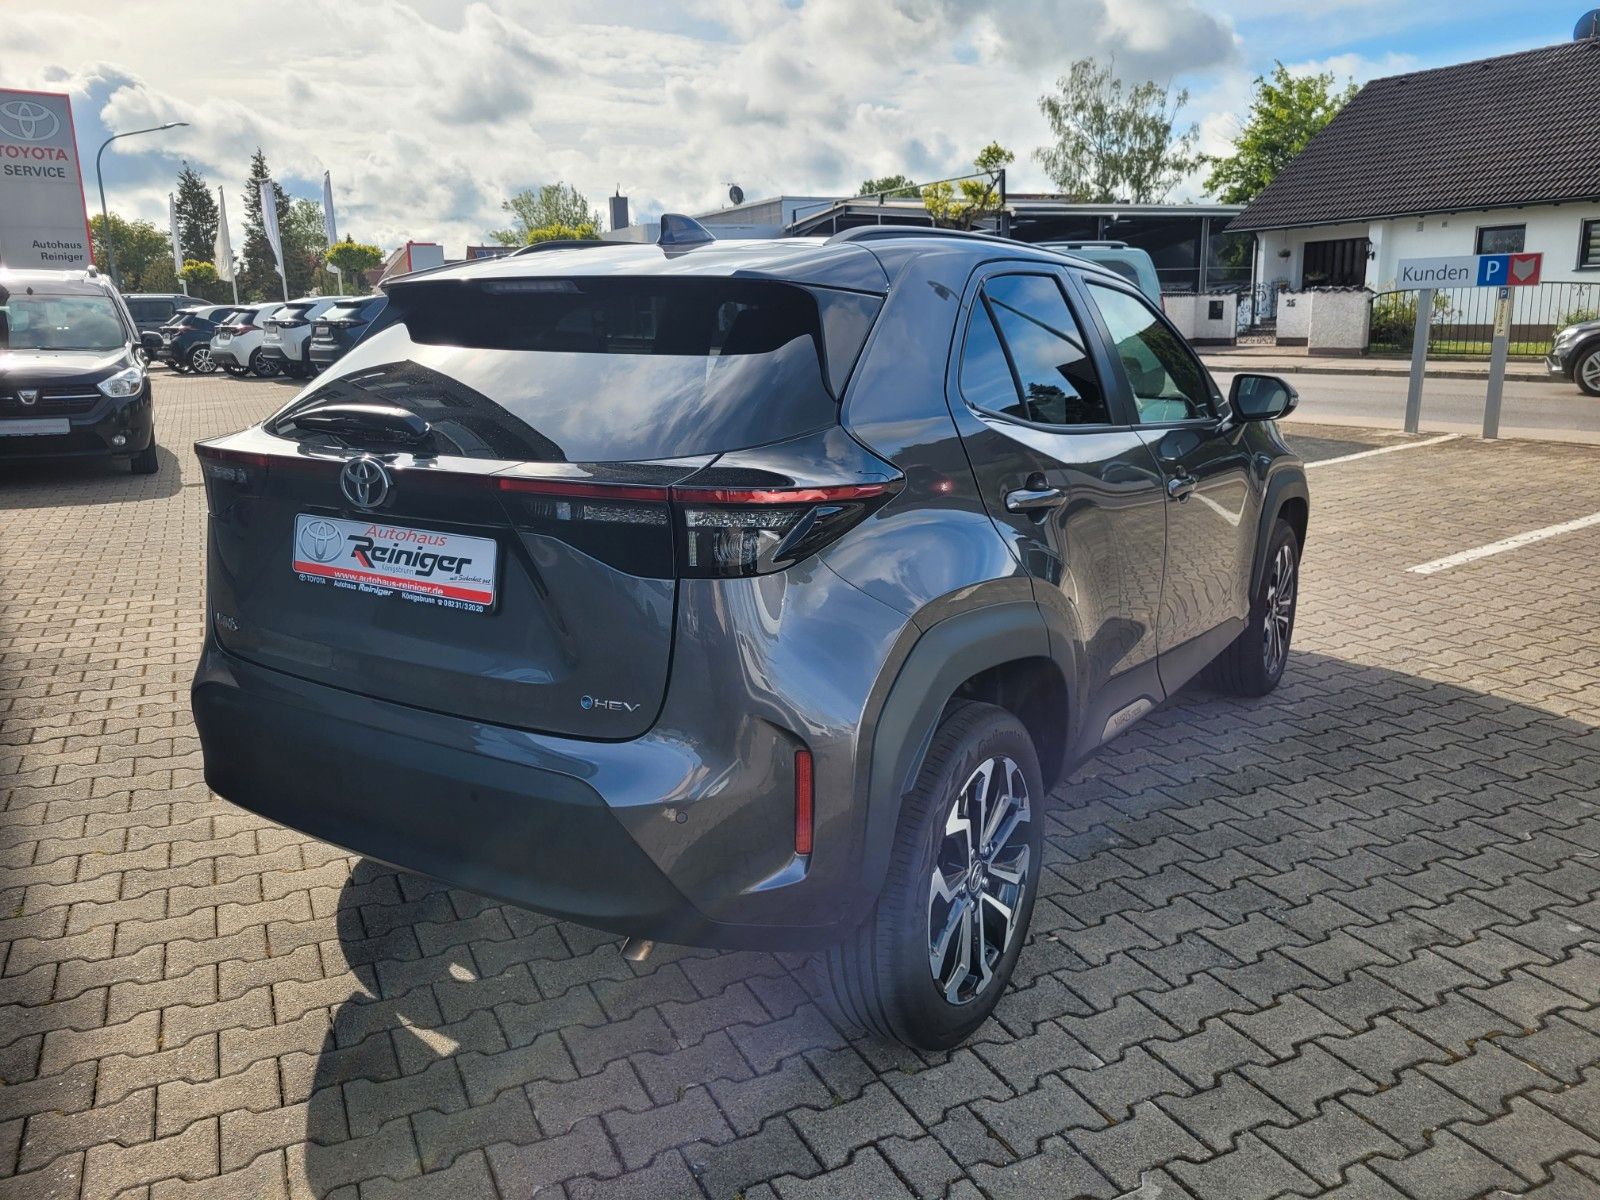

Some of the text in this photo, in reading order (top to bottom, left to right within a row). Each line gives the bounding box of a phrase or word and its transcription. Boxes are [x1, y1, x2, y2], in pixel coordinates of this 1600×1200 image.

[0, 145, 69, 161] TOYOTA
[4, 164, 66, 179] SERVICE
[32, 240, 82, 249] Autohaus
[41, 252, 84, 262] Reiniger
[1402, 260, 1500, 282] Kunden P
[363, 524, 448, 547] Autohaus
[347, 534, 473, 577] Reiniger
[307, 575, 326, 584] TOYOTA
[333, 580, 356, 590] Autohaus
[358, 583, 394, 596] Reiniger
[401, 592, 435, 604] Königsbrunn
[334, 571, 444, 596] www.autohaus-reiniger.de
[594, 699, 641, 712] HEV
